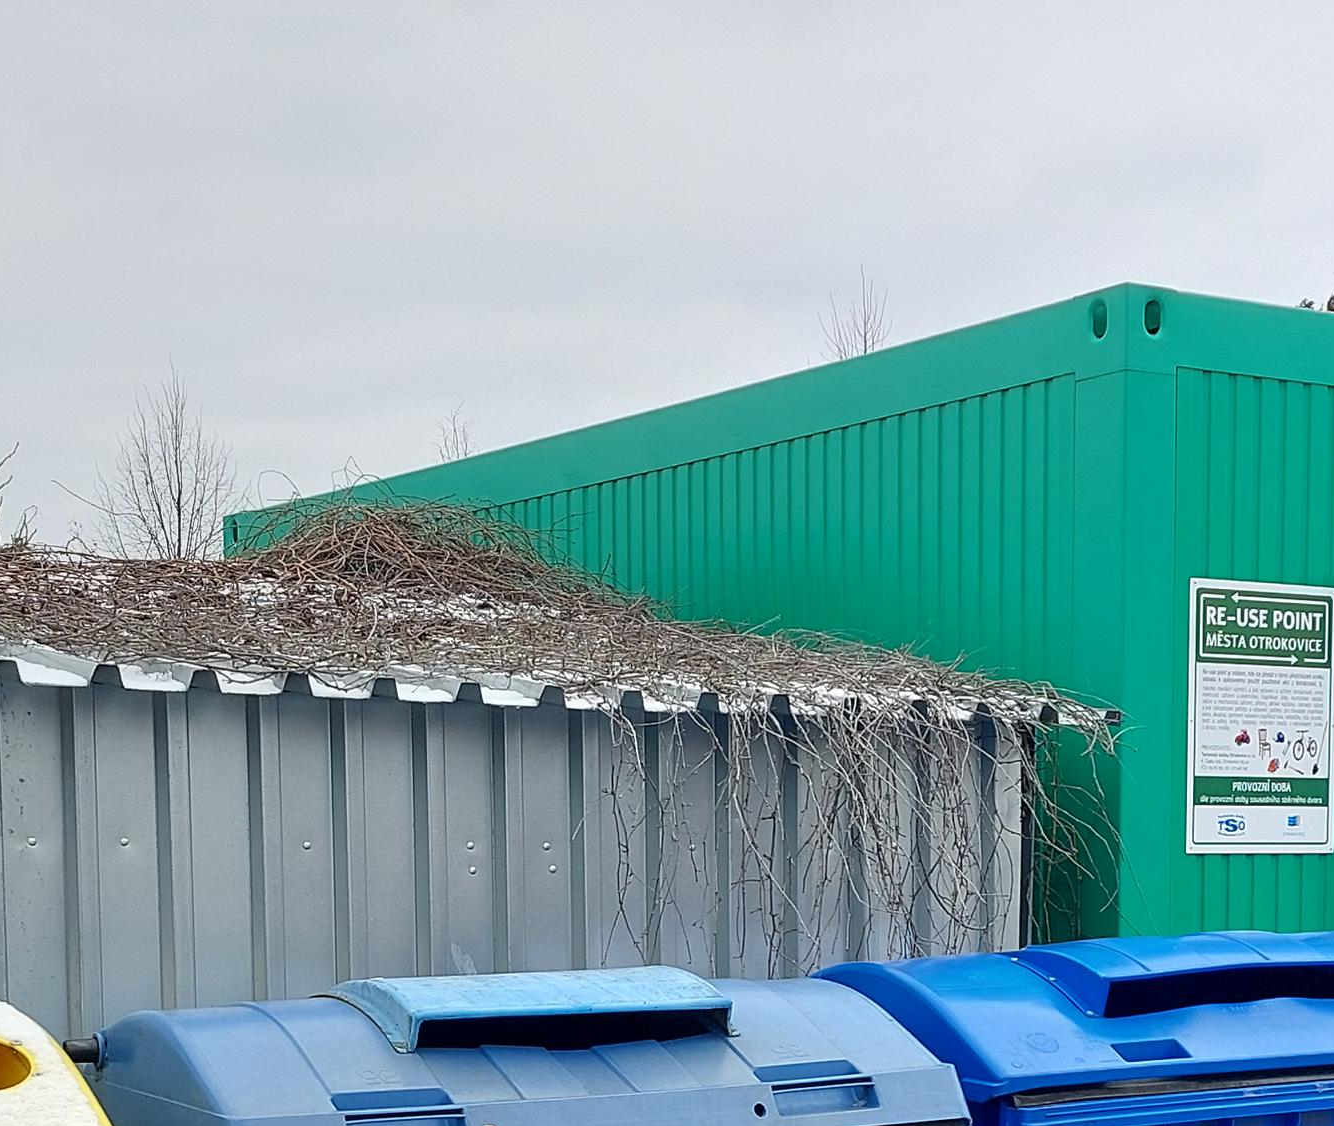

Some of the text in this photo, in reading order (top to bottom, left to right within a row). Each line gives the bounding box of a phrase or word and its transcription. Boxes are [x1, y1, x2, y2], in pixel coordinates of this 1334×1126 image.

[1206, 605, 1323, 631] RE-USE POINT
[1206, 630, 1323, 652] MĚSTA OTROKOVICE
[1232, 779, 1292, 793] PROVOZNÍ DOBA
[1217, 819, 1246, 833] TSO
